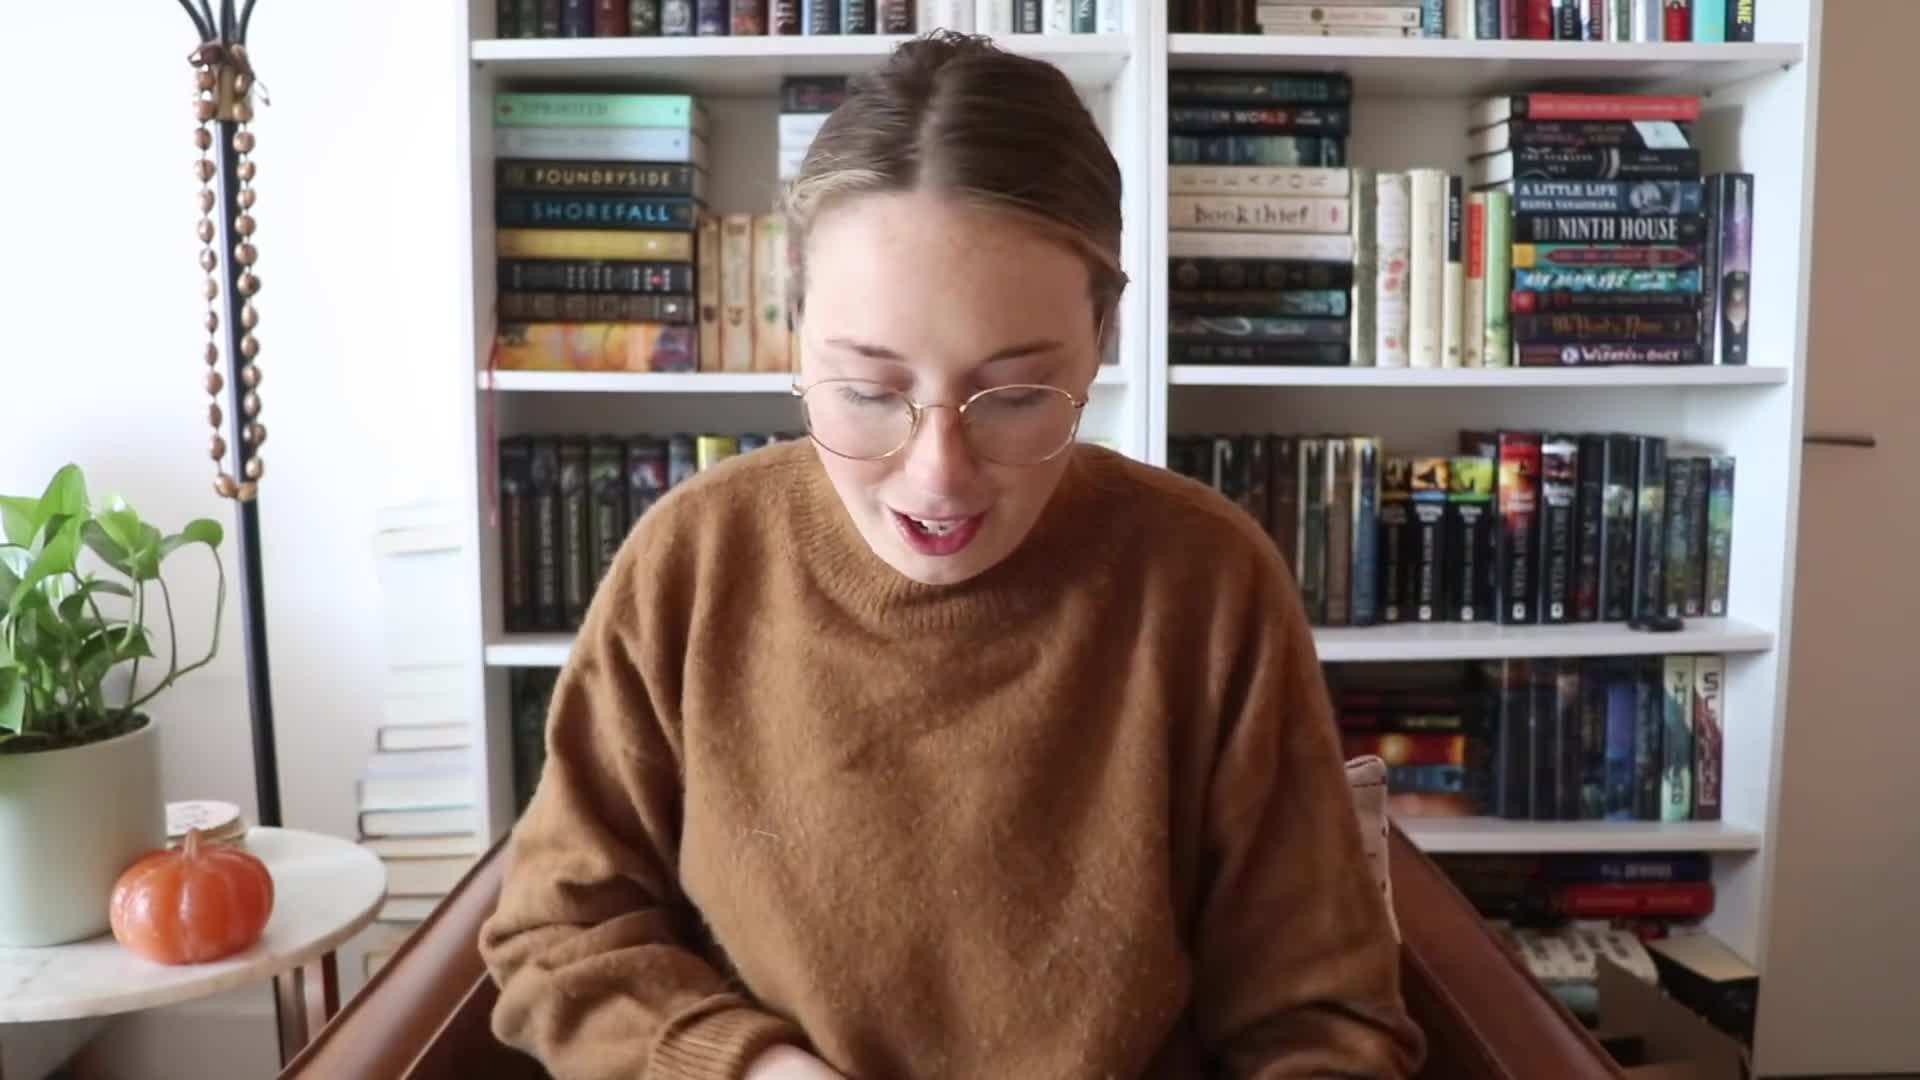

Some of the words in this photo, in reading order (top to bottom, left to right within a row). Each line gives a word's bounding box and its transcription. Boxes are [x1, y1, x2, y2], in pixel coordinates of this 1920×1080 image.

[535, 169, 672, 187] FOUNDRYSIDE
[1520, 184, 1533, 196] A
[1535, 184, 1584, 197] LITTLE
[1586, 184, 1617, 197] LIFE
[533, 202, 671, 222] SHOREFALL
[1194, 204, 1249, 225] book
[1256, 204, 1309, 225] thief
[1557, 216, 1616, 240] NINTH
[1620, 216, 1678, 240] HOUSE
